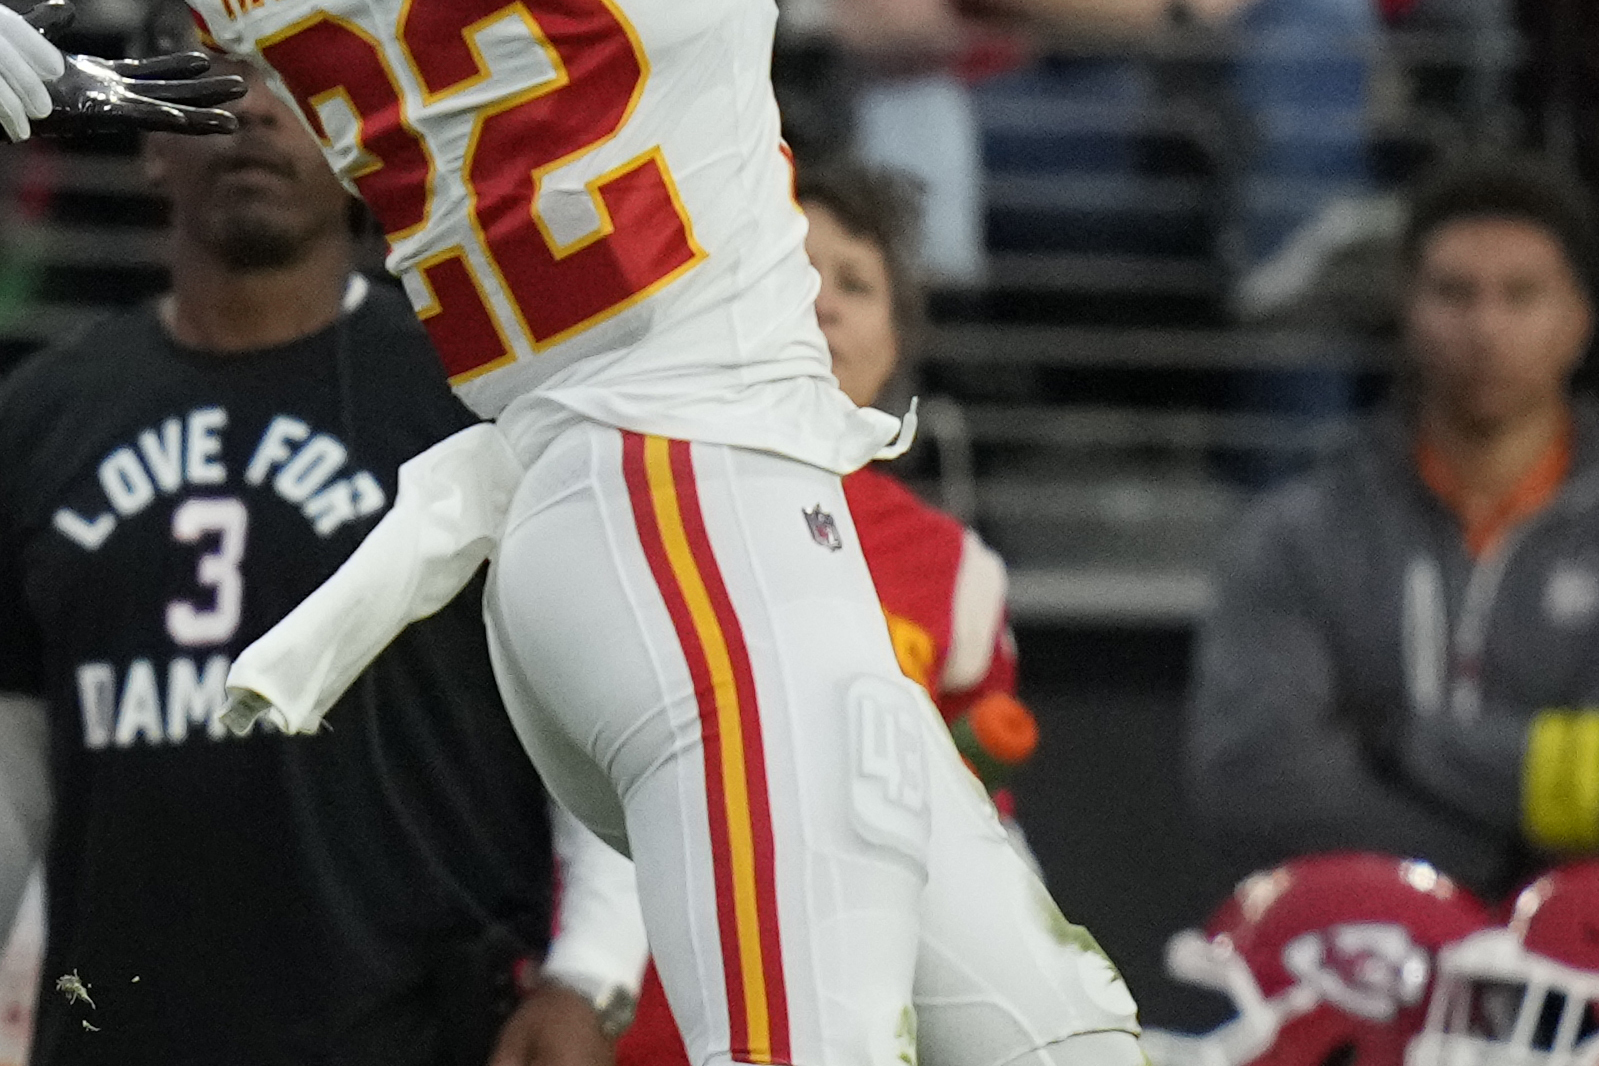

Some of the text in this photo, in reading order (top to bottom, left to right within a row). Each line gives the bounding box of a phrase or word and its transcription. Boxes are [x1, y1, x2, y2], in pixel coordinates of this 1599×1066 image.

[52, 404, 386, 551] LOVE FOR
[164, 494, 250, 647] 3
[75, 652, 262, 750] DAM
